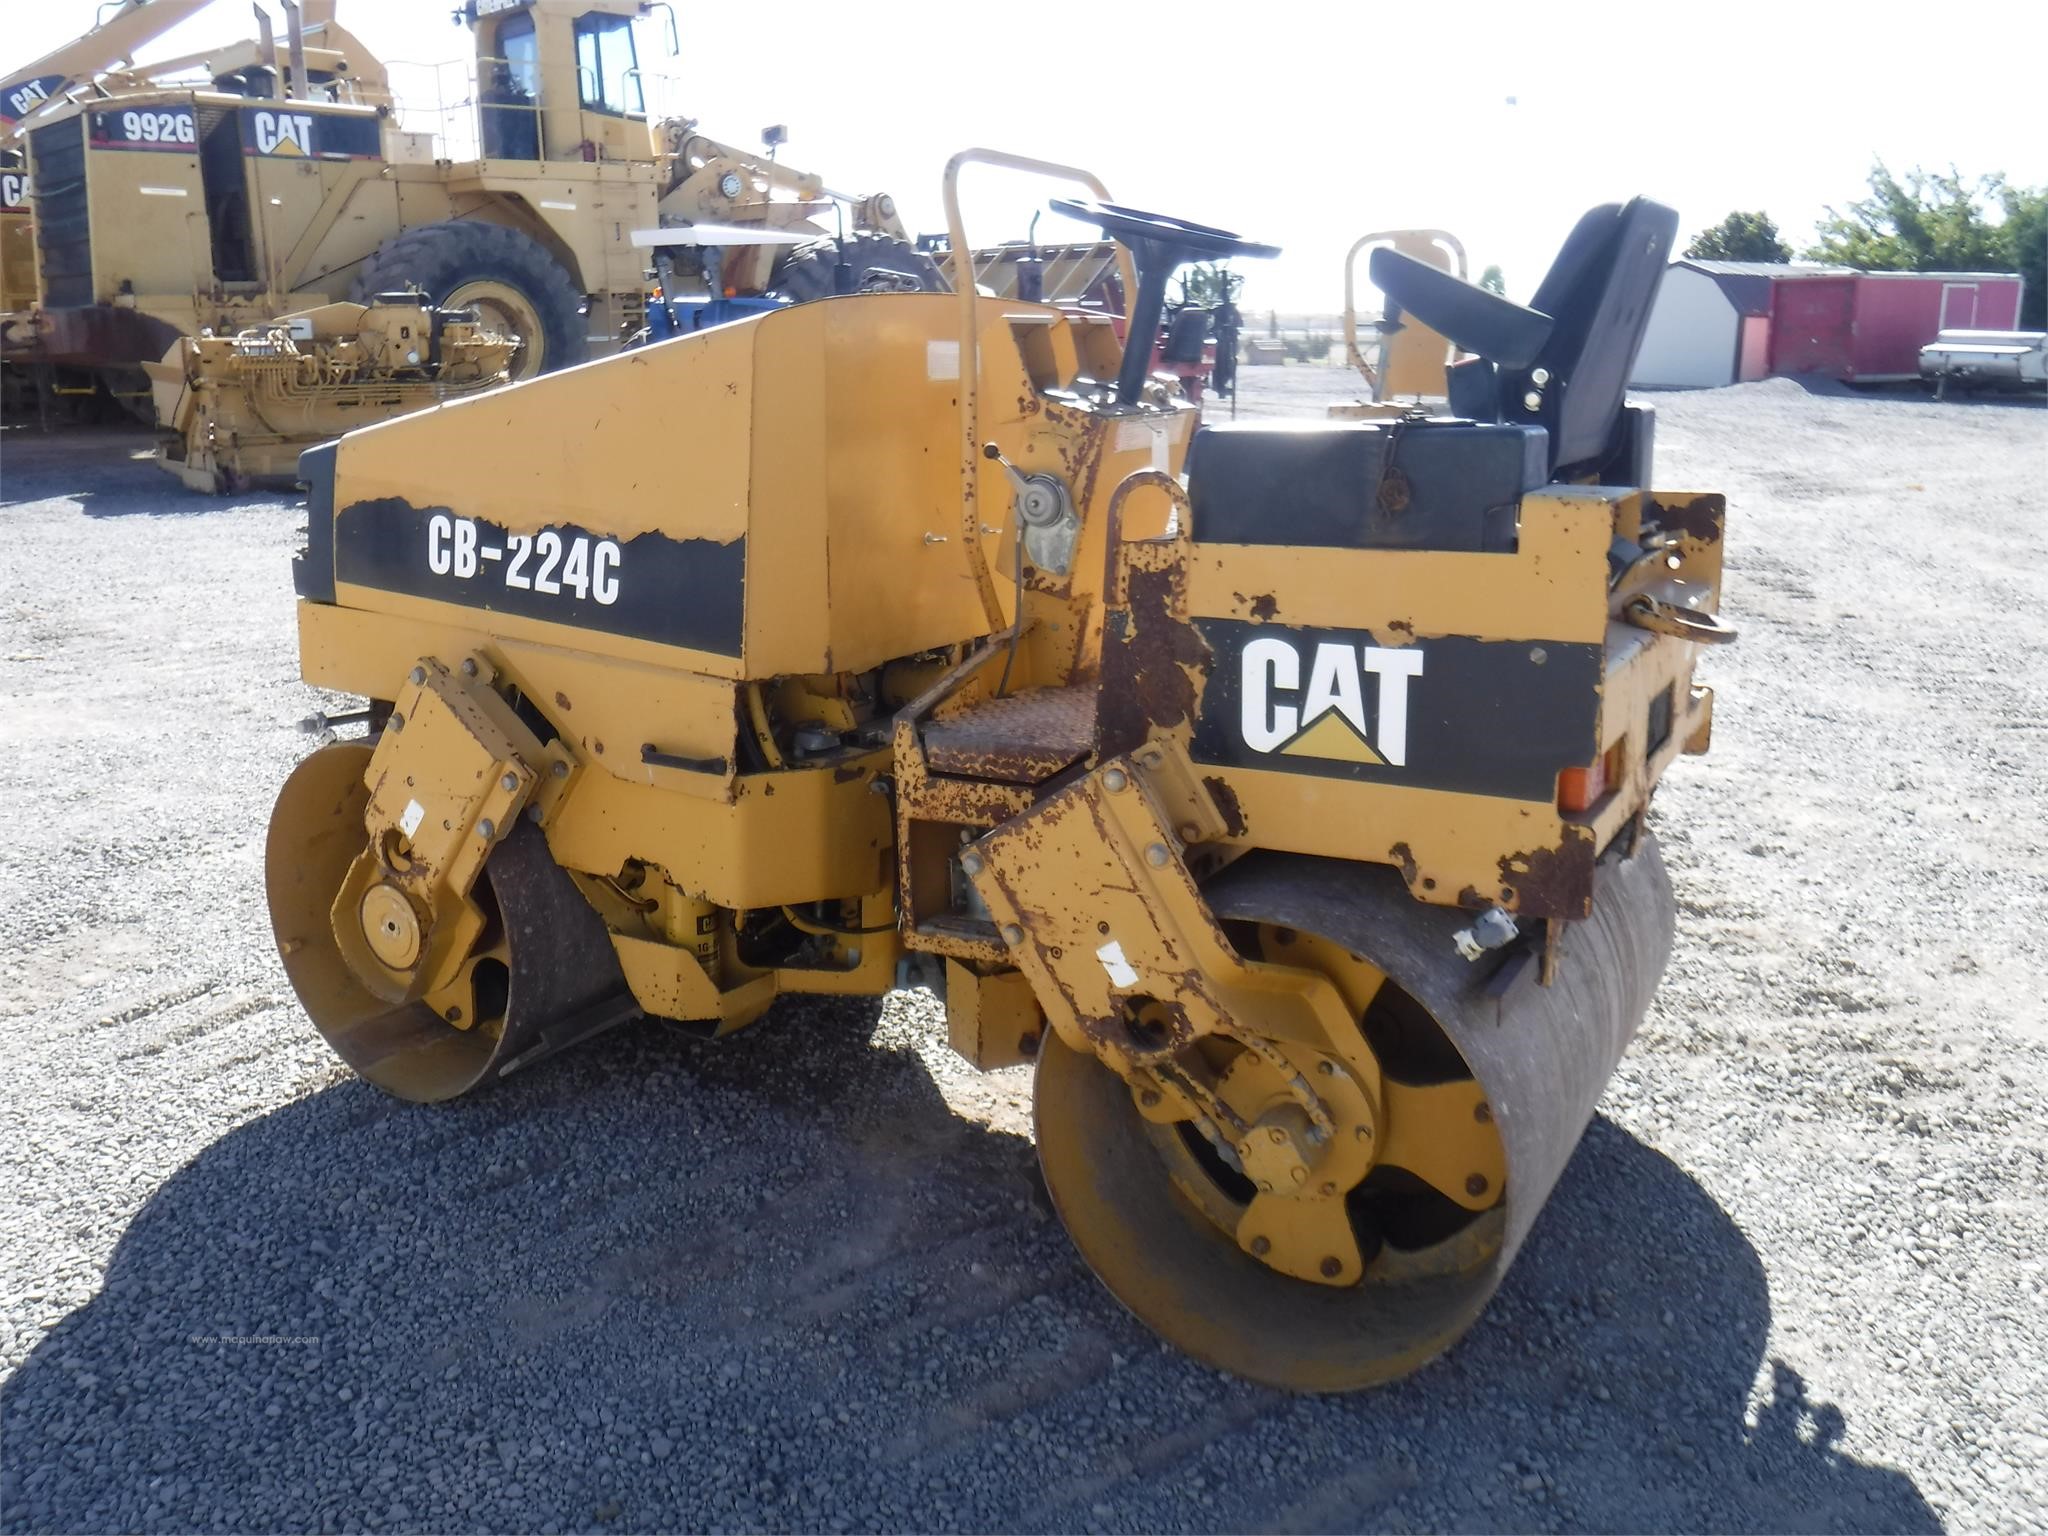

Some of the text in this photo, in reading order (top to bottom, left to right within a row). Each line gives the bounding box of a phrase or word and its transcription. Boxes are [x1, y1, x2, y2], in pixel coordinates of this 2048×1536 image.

[10, 80, 48, 114] CAT
[123, 111, 195, 143] 992G
[255, 111, 312, 156] CAT
[428, 515, 621, 605] CB-224C
[1241, 638, 1424, 766] CAT
